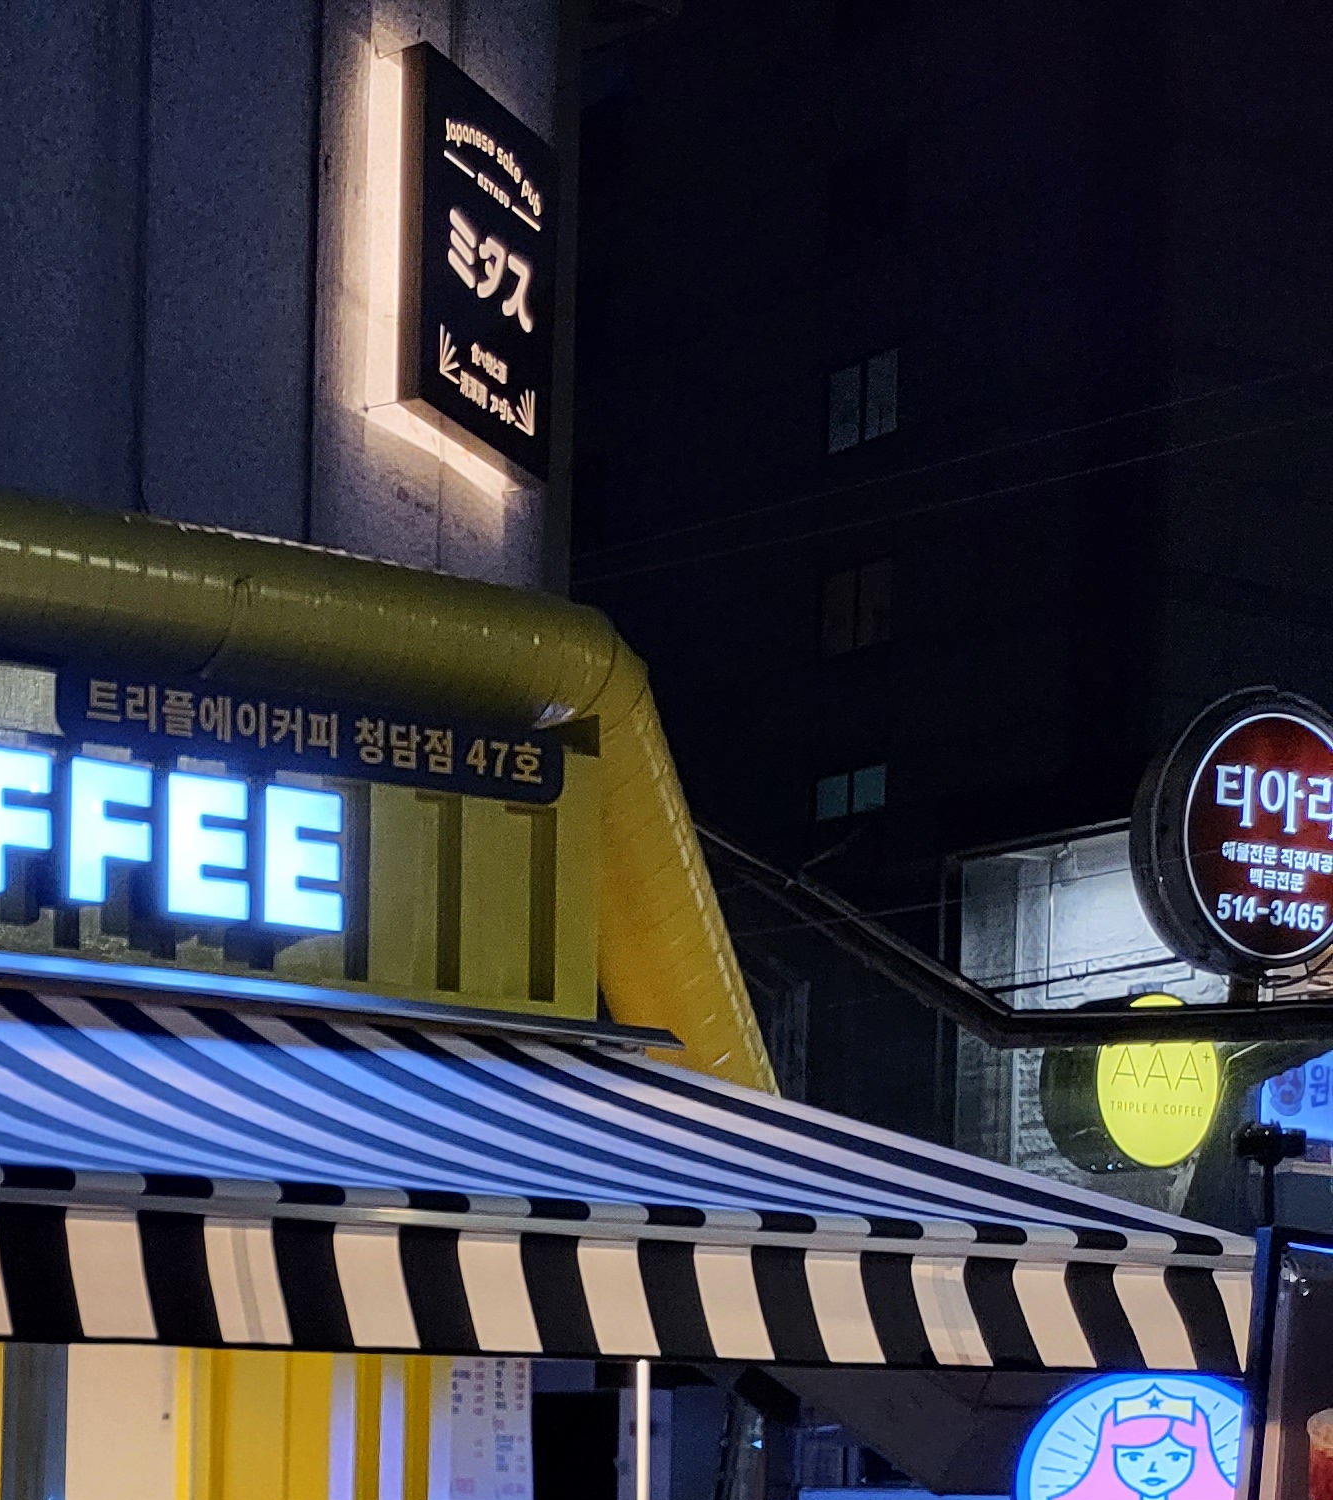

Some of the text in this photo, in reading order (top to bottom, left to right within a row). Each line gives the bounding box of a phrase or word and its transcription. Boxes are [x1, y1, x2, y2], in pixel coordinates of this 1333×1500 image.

[445, 117, 542, 217] Japanese sake pub
[448, 207, 534, 333] ミタス
[86, 678, 544, 785] 트리플에이커피 청담점 47호
[1216, 893, 1326, 932] 514-3465
[1249, 868, 1305, 893] 백금전문
[1111, 1100, 1203, 1117] TRIPLE A COFFEE
